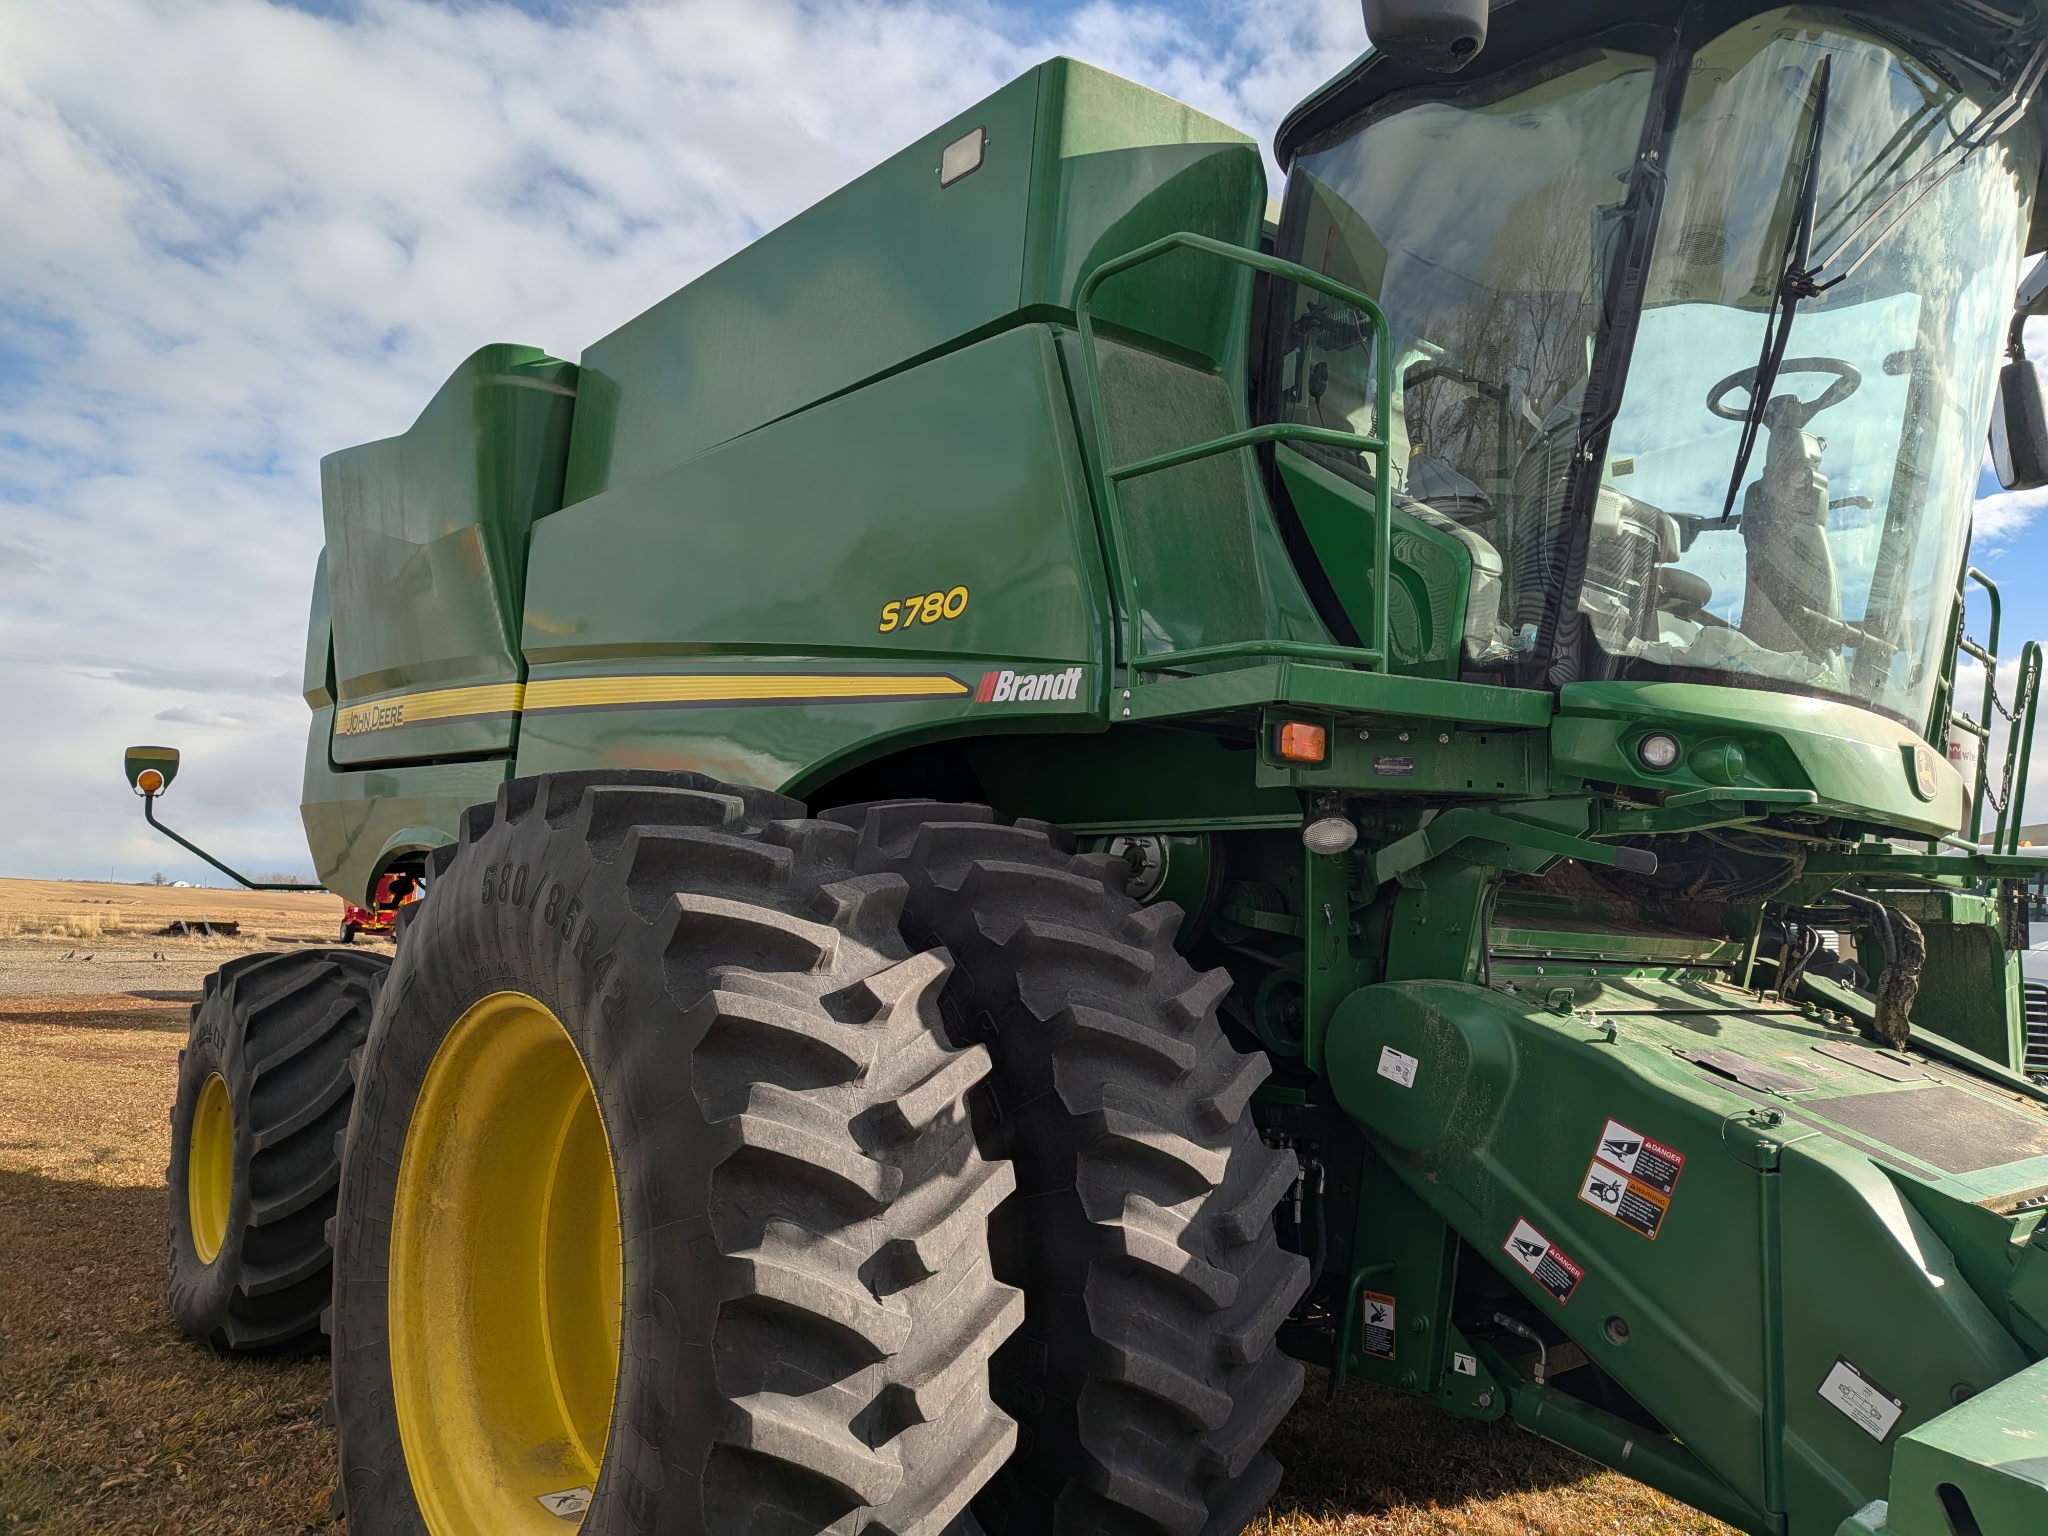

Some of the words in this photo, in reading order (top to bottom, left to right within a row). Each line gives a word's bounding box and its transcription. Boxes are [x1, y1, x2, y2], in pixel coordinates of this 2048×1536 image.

[878, 584, 969, 634] S780
[992, 667, 1083, 702] Brandt
[347, 711, 371, 733] JOHN
[371, 705, 404, 728] DEERE
[1650, 1143, 1682, 1164] DANGER
[1634, 1187, 1666, 1206] WARNING
[1554, 1252, 1581, 1278] DANGER
